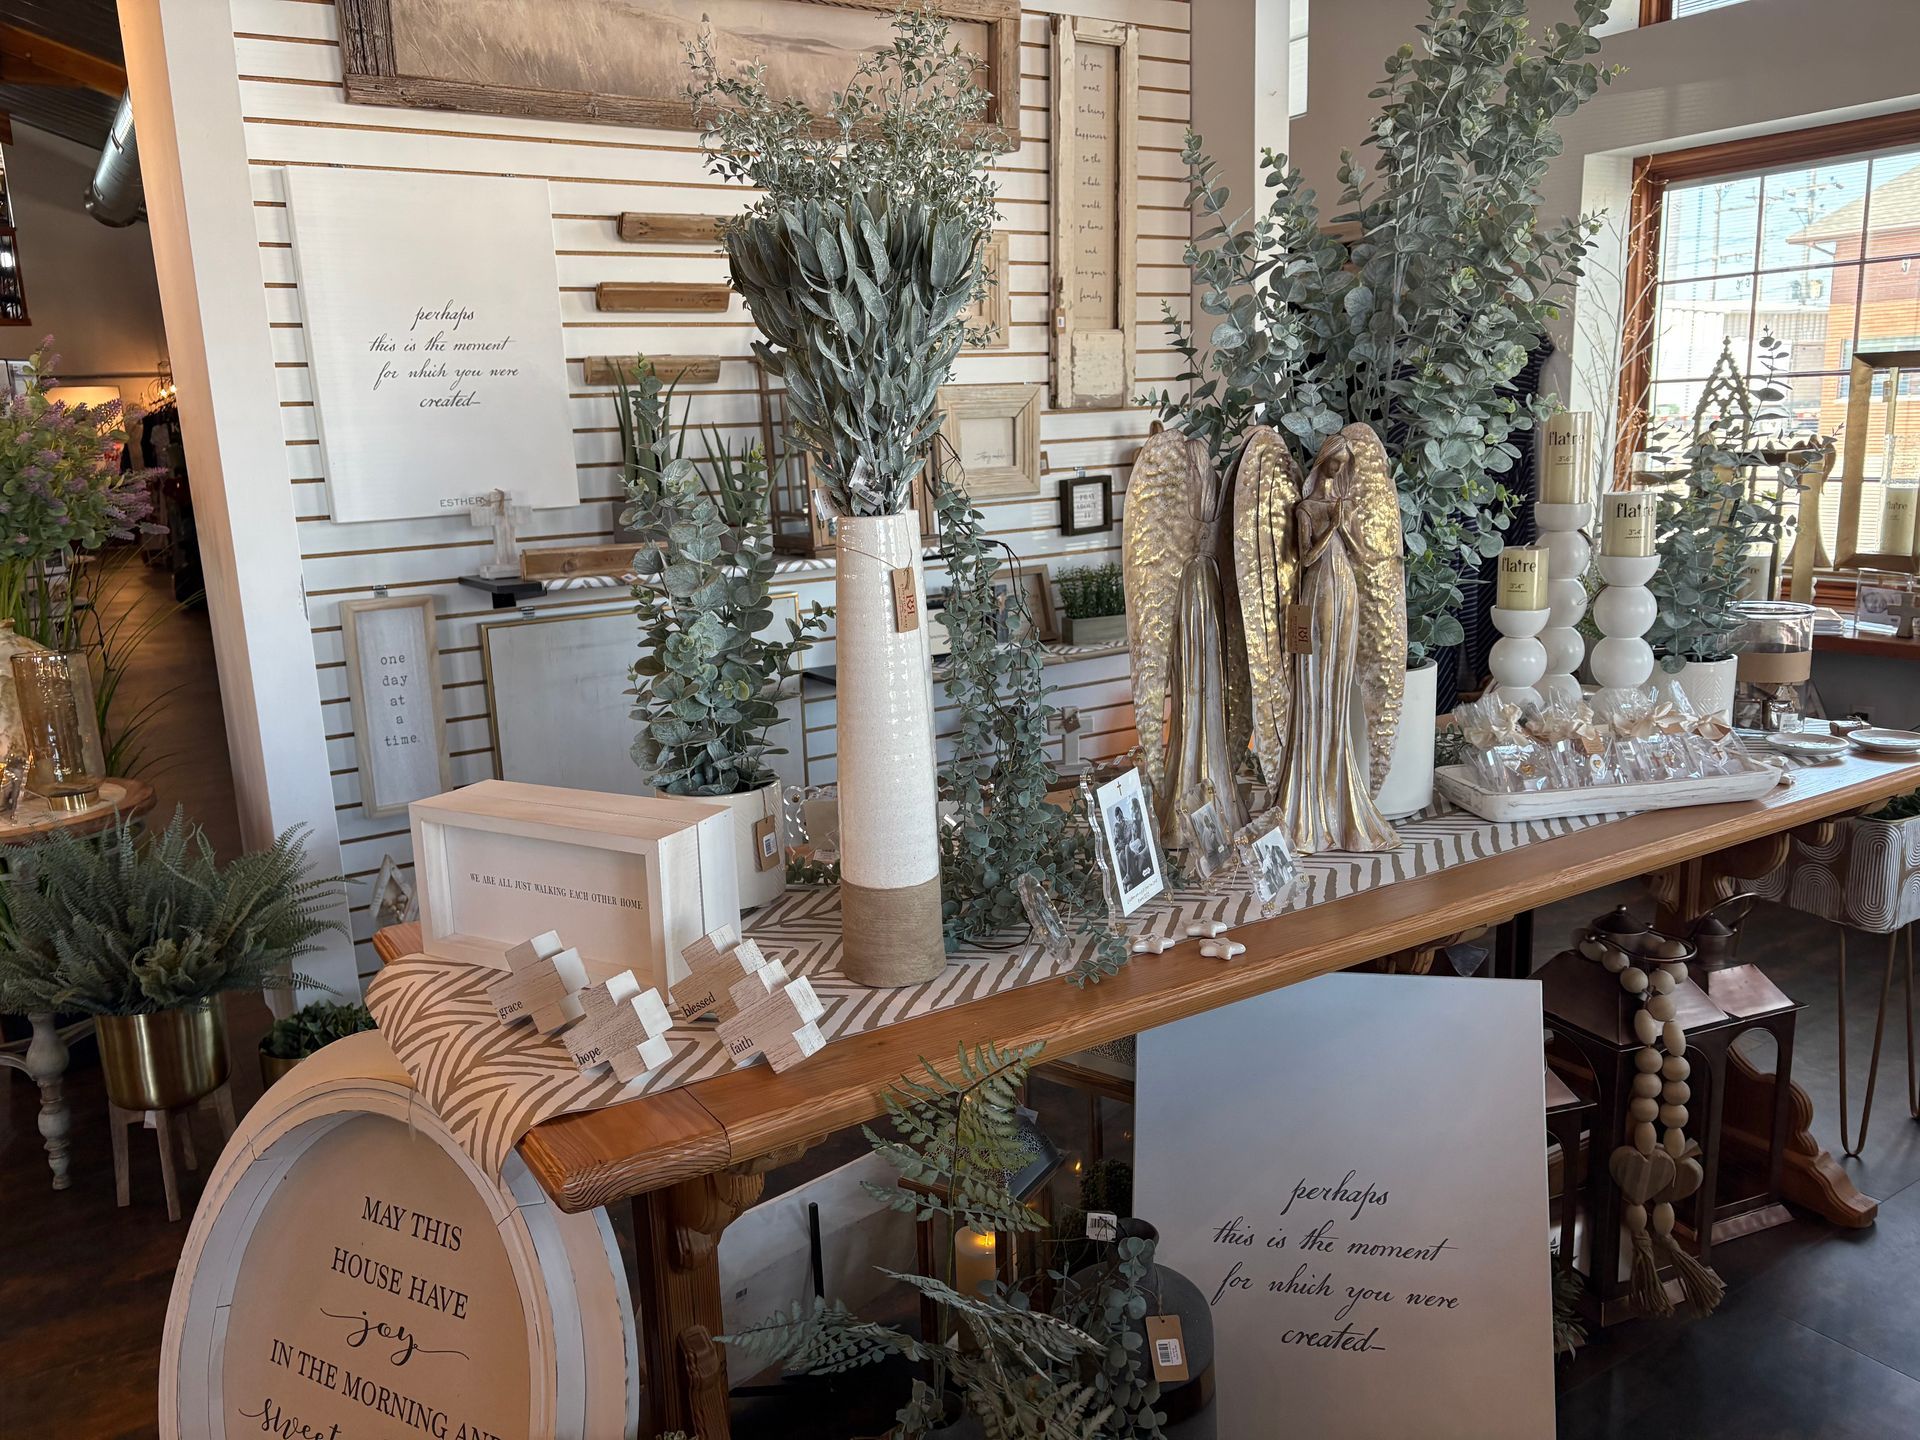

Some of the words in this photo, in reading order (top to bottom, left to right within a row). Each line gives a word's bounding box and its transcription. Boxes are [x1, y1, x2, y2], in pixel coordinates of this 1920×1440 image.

[1088, 104, 1106, 120] bring
[1080, 288, 1102, 302] family
[410, 299, 474, 331] perhaps
[368, 333, 396, 352] this
[404, 338, 416, 351] is
[424, 330, 448, 352] the
[453, 336, 517, 351] moment
[373, 361, 400, 391] for
[408, 358, 448, 378] which
[449, 369, 483, 391] you
[490, 368, 520, 377] were
[1616, 503, 1654, 519] flaire
[1502, 557, 1536, 573] flaire
[380, 654, 406, 666] one
[382, 674, 408, 687] day
[390, 694, 406, 706] at
[396, 716, 404, 724] a
[470, 873, 480, 883] WE
[482, 875, 496, 886] ARE
[498, 878, 512, 888] ALL
[515, 880, 532, 892] JUST
[534, 884, 567, 898] WALKING
[570, 889, 589, 901] EACH
[591, 893, 618, 906] OTHER
[620, 898, 643, 910] HOME
[499, 1000, 524, 1020] grace
[682, 992, 716, 1018] blessed
[576, 1047, 600, 1066] hope
[730, 1036, 754, 1056] faith
[1280, 1170, 1388, 1220] perhaps
[361, 1196, 407, 1232] MAY
[410, 1212, 463, 1252] THIS
[1212, 1216, 1254, 1246] this
[1267, 1228, 1287, 1248] is
[1299, 1220, 1339, 1253] the
[1348, 1238, 1459, 1261] moment
[331, 1246, 404, 1296] HOUSE
[408, 1276, 469, 1320] HAVE
[1211, 1262, 1253, 1306] for
[1268, 1263, 1334, 1296] which
[1334, 1285, 1394, 1321] you
[1406, 1294, 1460, 1309] were
[270, 1338, 294, 1369] IN
[297, 1350, 338, 1390] THE
[342, 1371, 448, 1438] MORNING
[455, 1422, 506, 1440] AN
